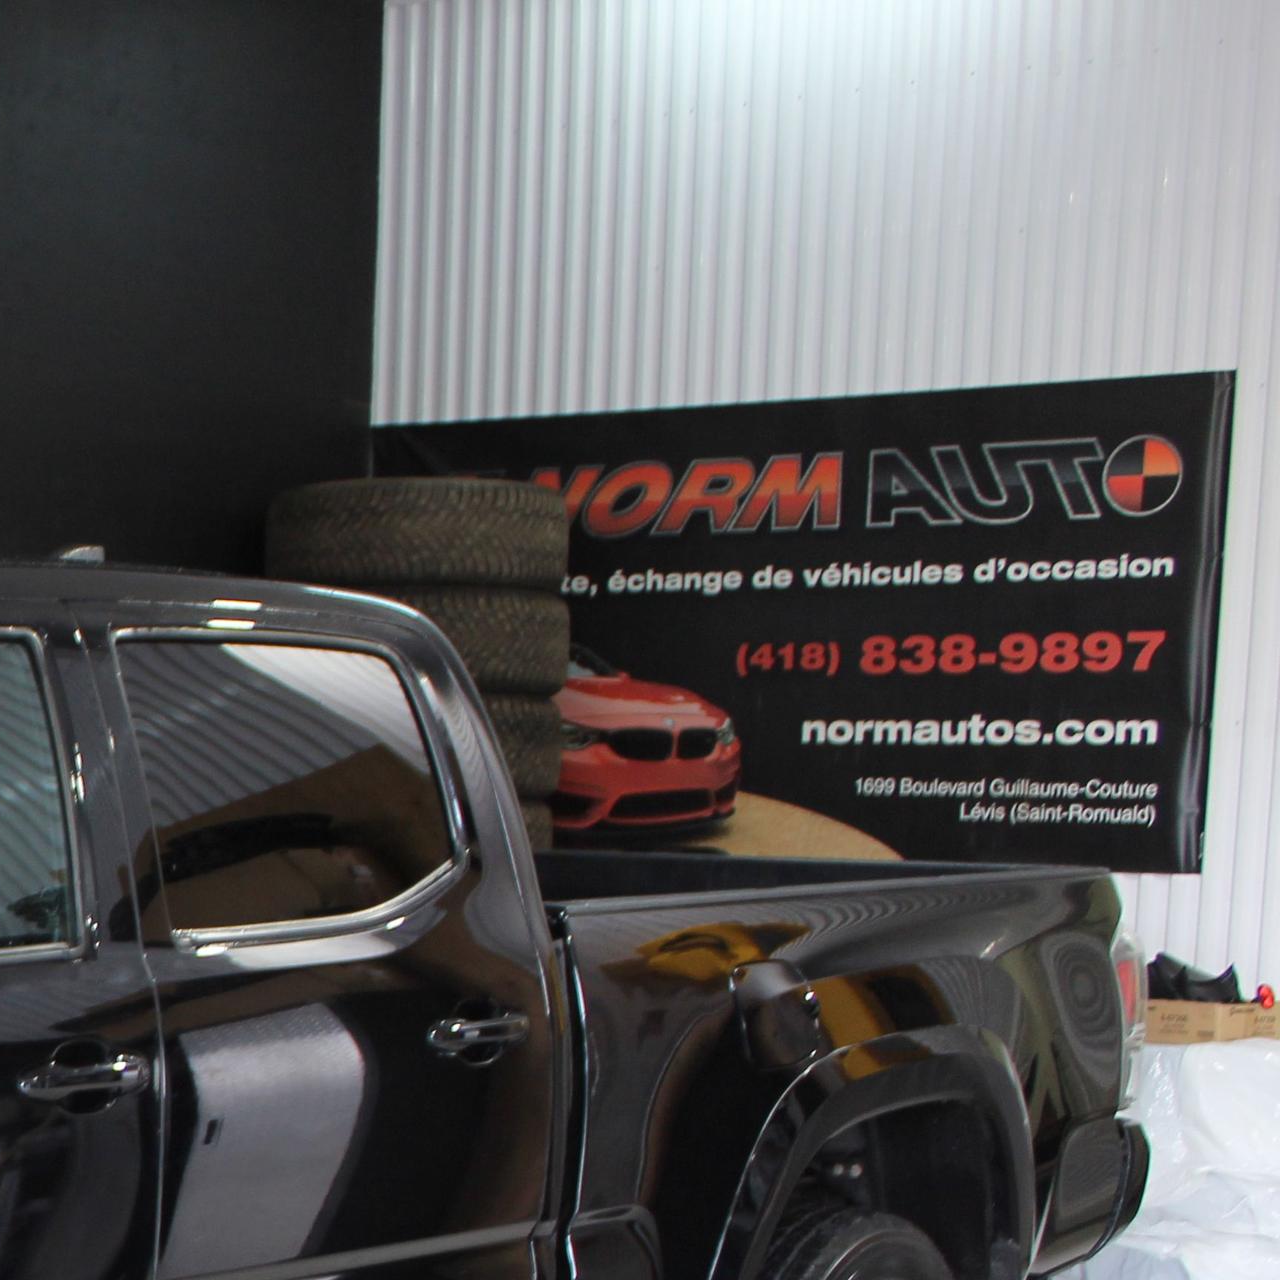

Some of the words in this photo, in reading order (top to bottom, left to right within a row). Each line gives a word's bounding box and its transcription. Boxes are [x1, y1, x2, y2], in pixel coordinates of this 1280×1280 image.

[607, 568, 743, 595] échange
[752, 565, 793, 590] de
[803, 559, 964, 588] véhicules
[973, 553, 1175, 583] d'occasion
[736, 640, 840, 678] (418)
[859, 629, 1167, 676] 838-9897
[800, 713, 1159, 746] normautos.com
[854, 777, 896, 797] 1699
[899, 776, 986, 797] Boulevard
[990, 778, 1159, 800] Guillaume-Couture
[959, 803, 1006, 824] Lévis
[1010, 803, 1156, 828] (Saint-Romuald)
